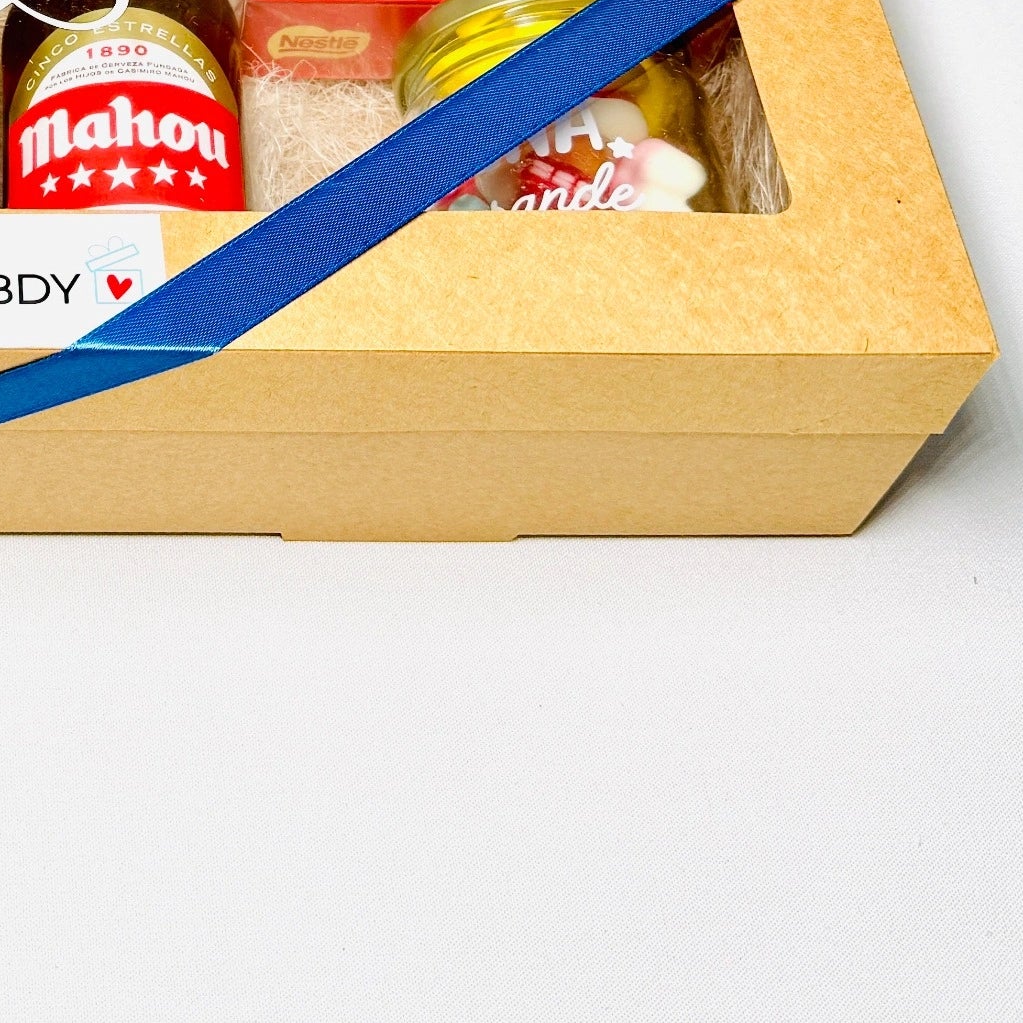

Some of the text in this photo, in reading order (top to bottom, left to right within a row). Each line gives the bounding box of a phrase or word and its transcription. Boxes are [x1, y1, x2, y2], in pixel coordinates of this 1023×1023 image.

[26, 21, 217, 92] CINCO ESTRELLAS
[86, 45, 148, 59] 1890
[19, 95, 230, 179] Mahou
